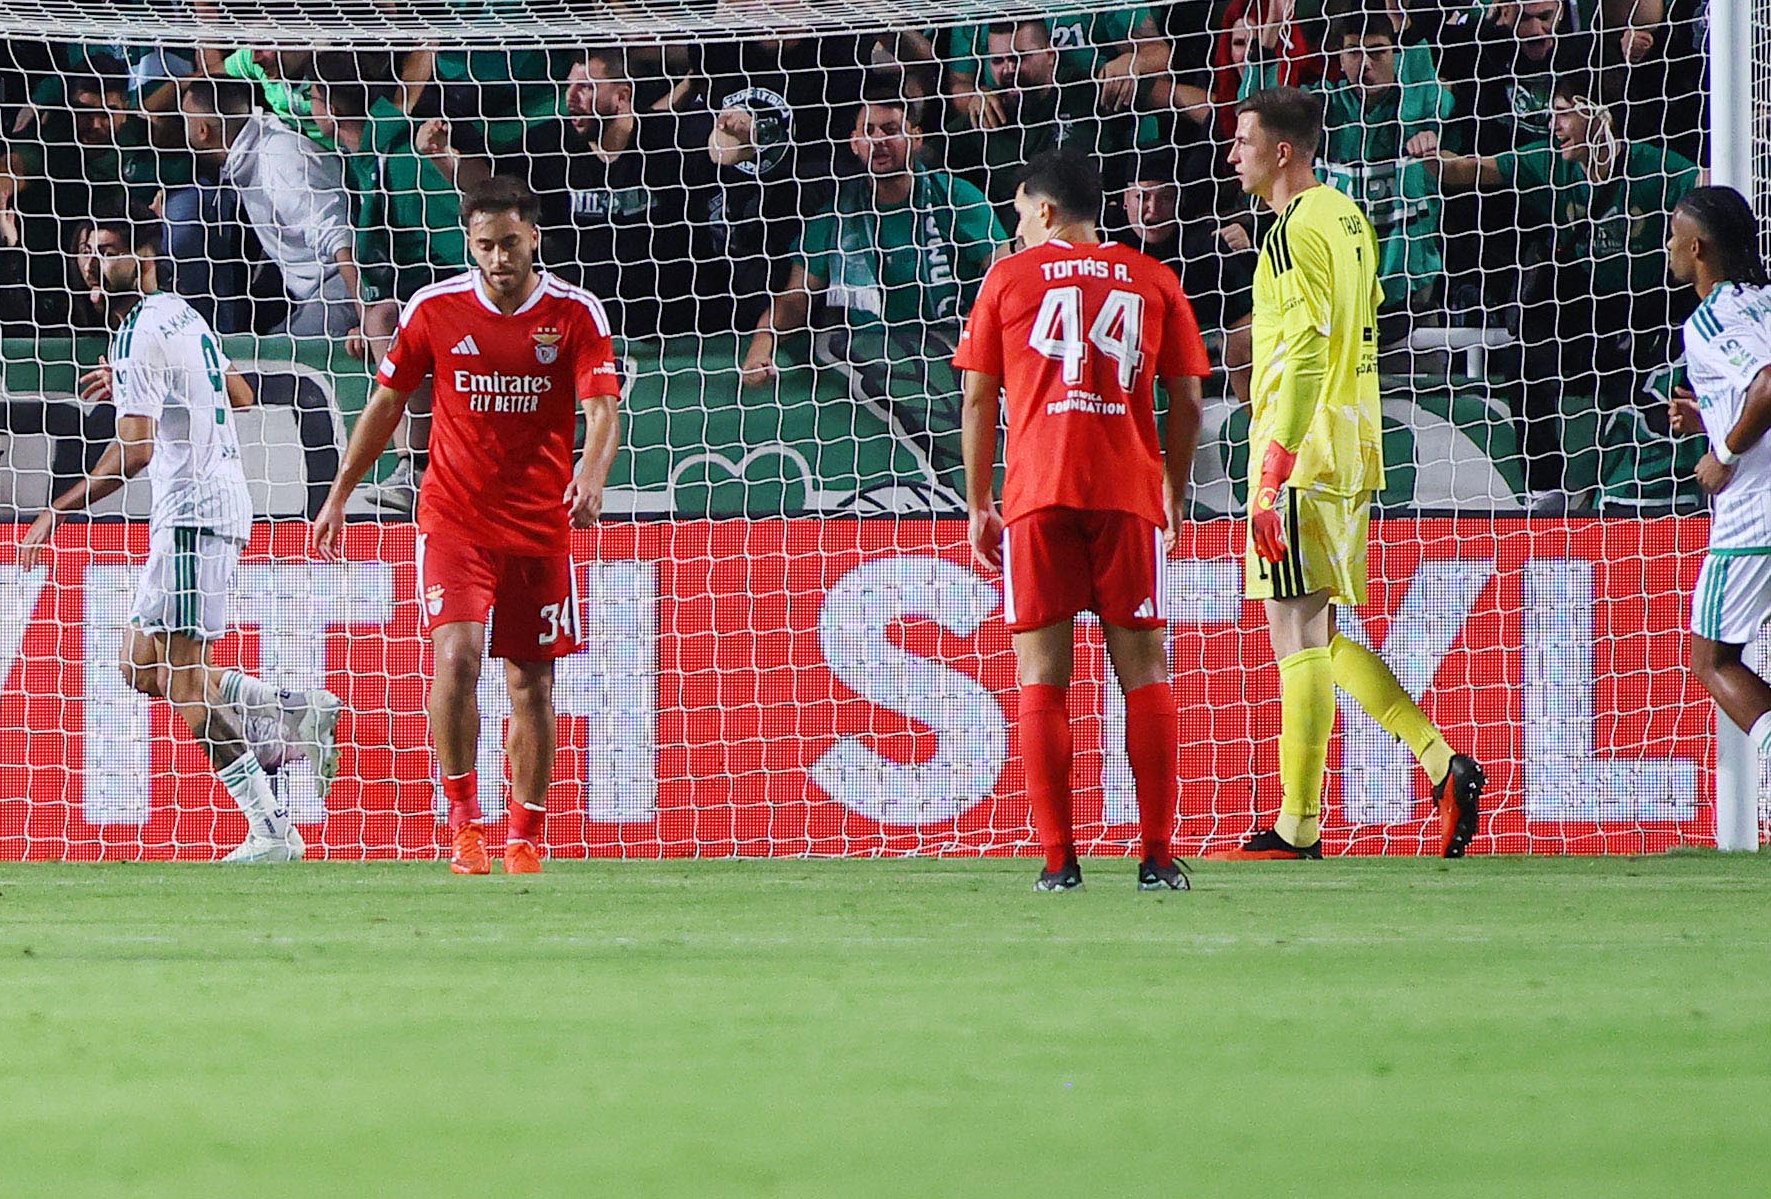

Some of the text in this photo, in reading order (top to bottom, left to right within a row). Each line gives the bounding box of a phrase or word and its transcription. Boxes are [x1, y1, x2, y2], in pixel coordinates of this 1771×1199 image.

[1040, 257, 1133, 283] TOMÁS A.
[1028, 285, 1145, 394] 44
[453, 369, 552, 393] Emirates
[469, 394, 539, 414] FLY BETTER
[1046, 400, 1126, 416] FOUNDATION
[538, 597, 572, 646] 34
